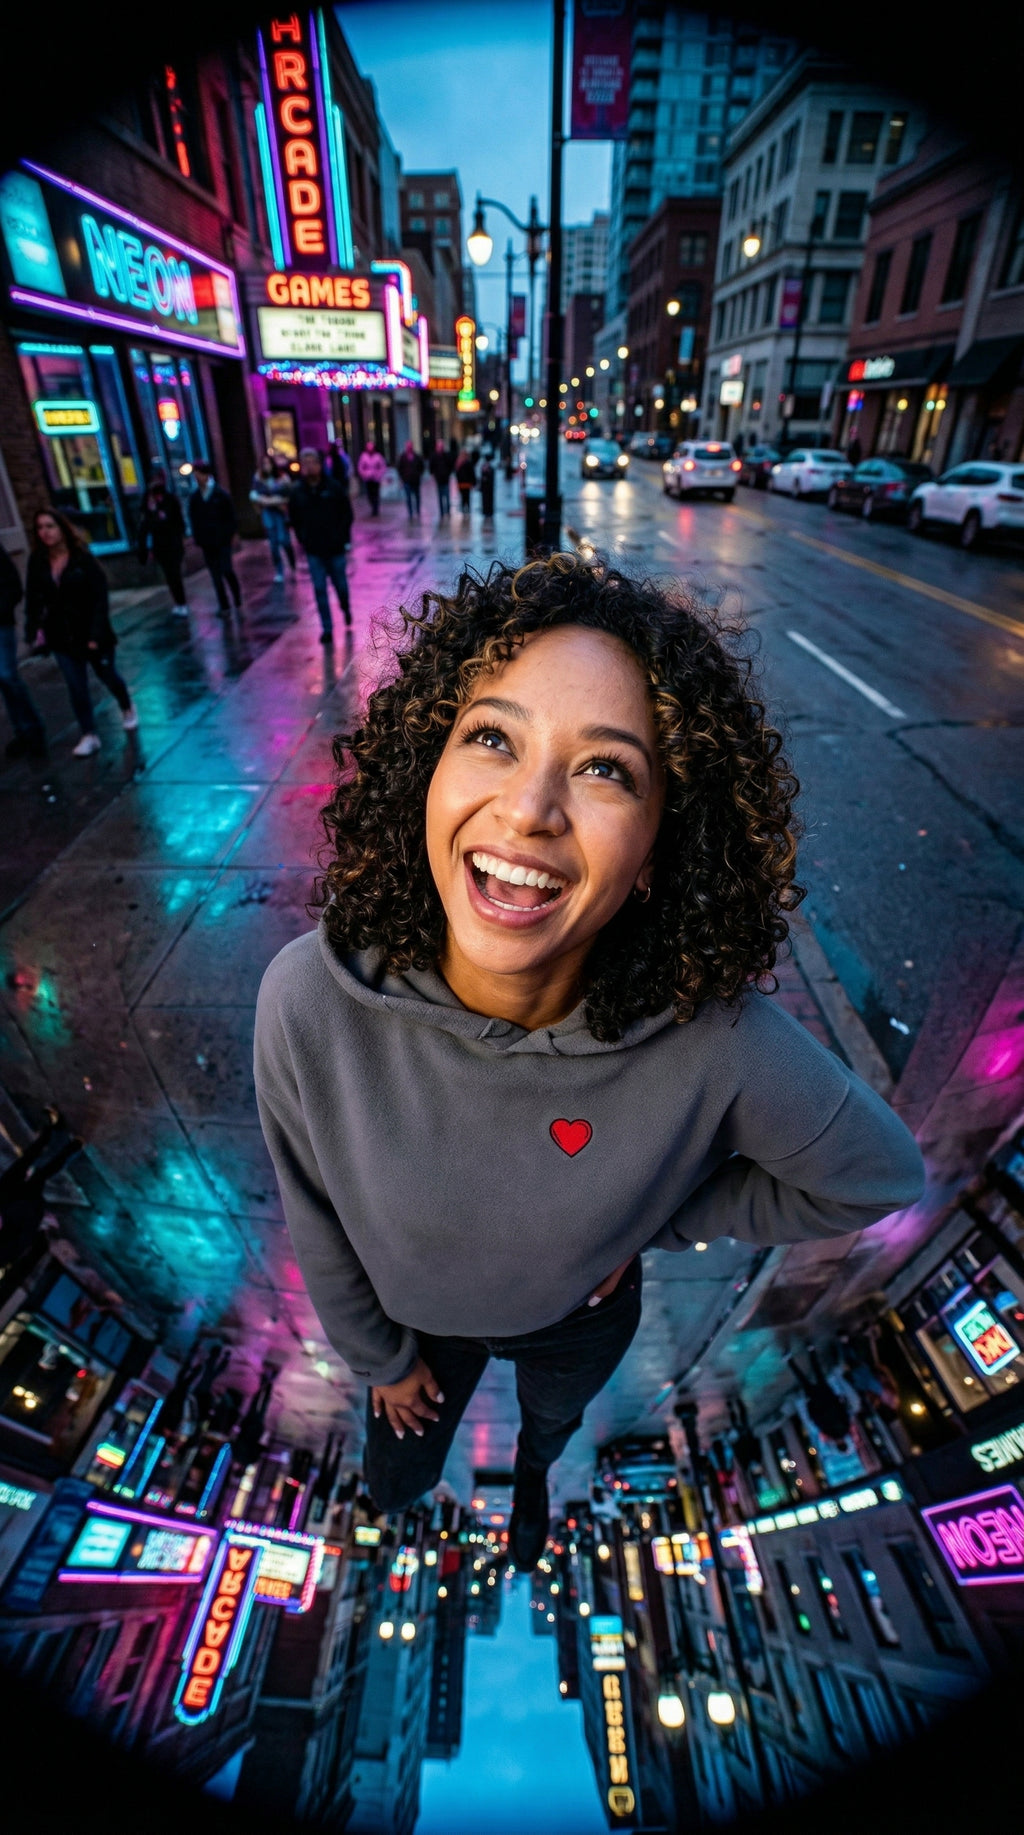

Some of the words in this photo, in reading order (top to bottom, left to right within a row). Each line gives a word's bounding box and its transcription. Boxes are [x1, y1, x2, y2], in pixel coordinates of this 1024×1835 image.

[81, 213, 199, 326] NEON
[267, 273, 371, 308] GAMES
[937, 1504, 1024, 1569] NEON
